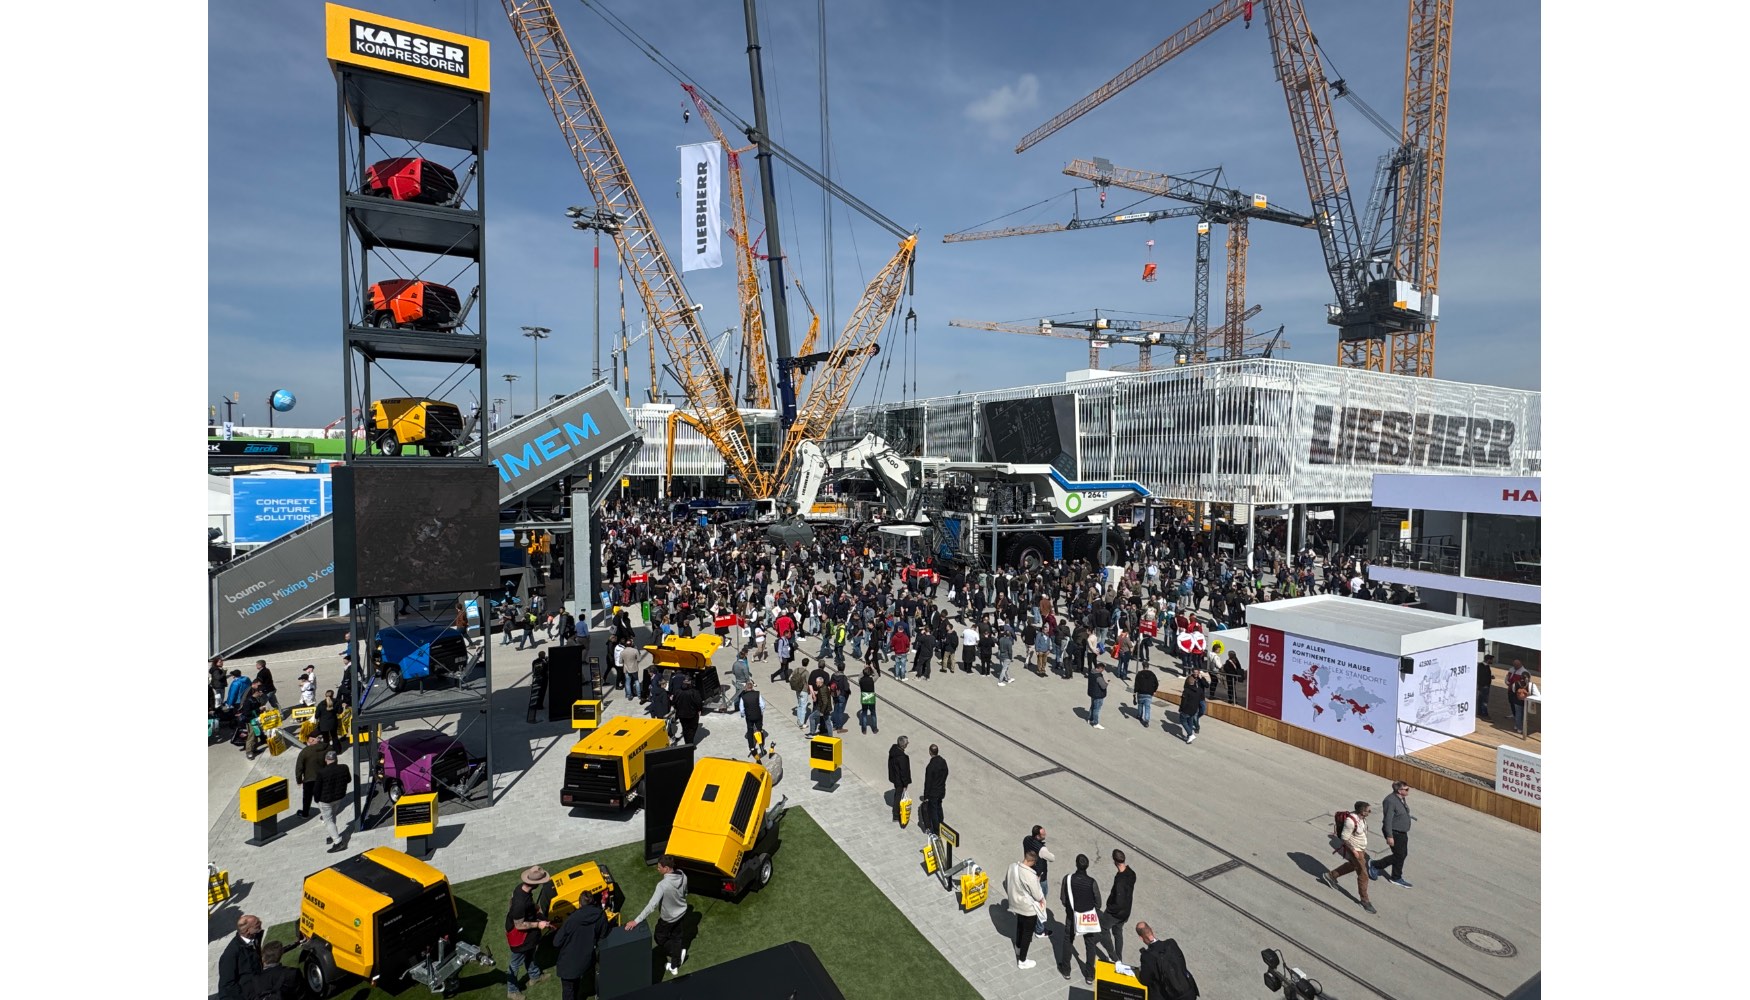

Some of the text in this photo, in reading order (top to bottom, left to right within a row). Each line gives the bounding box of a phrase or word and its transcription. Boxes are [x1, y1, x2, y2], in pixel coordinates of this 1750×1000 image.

[355, 24, 464, 63] KAESER
[356, 41, 464, 74] KOMPRESSOREN
[695, 161, 708, 255] LIEBHERR
[1309, 404, 1516, 468] LIEBHERR
[255, 498, 318, 506] CONCRETE
[1502, 489, 1541, 502] HA
[224, 580, 267, 603] bauma
[236, 597, 274, 619] Mobile
[272, 579, 309, 601] Mixing
[1258, 633, 1270, 644] 41
[1257, 650, 1277, 663] 462
[1306, 644, 1326, 653] ALLEN
[1292, 649, 1371, 673] KONTINENTEN ZU HAUSE
[1345, 670, 1388, 686] STANDORTE
[1457, 701, 1469, 714] 150
[628, 741, 648, 760] KAESER
[1502, 767, 1532, 781] KEEPS
[1503, 759, 1541, 775] HANSA-
[1502, 775, 1541, 793] BUSINES
[1502, 783, 1541, 801] MOVING
[303, 890, 326, 911] KAESER
[1082, 913, 1098, 923] PERI
